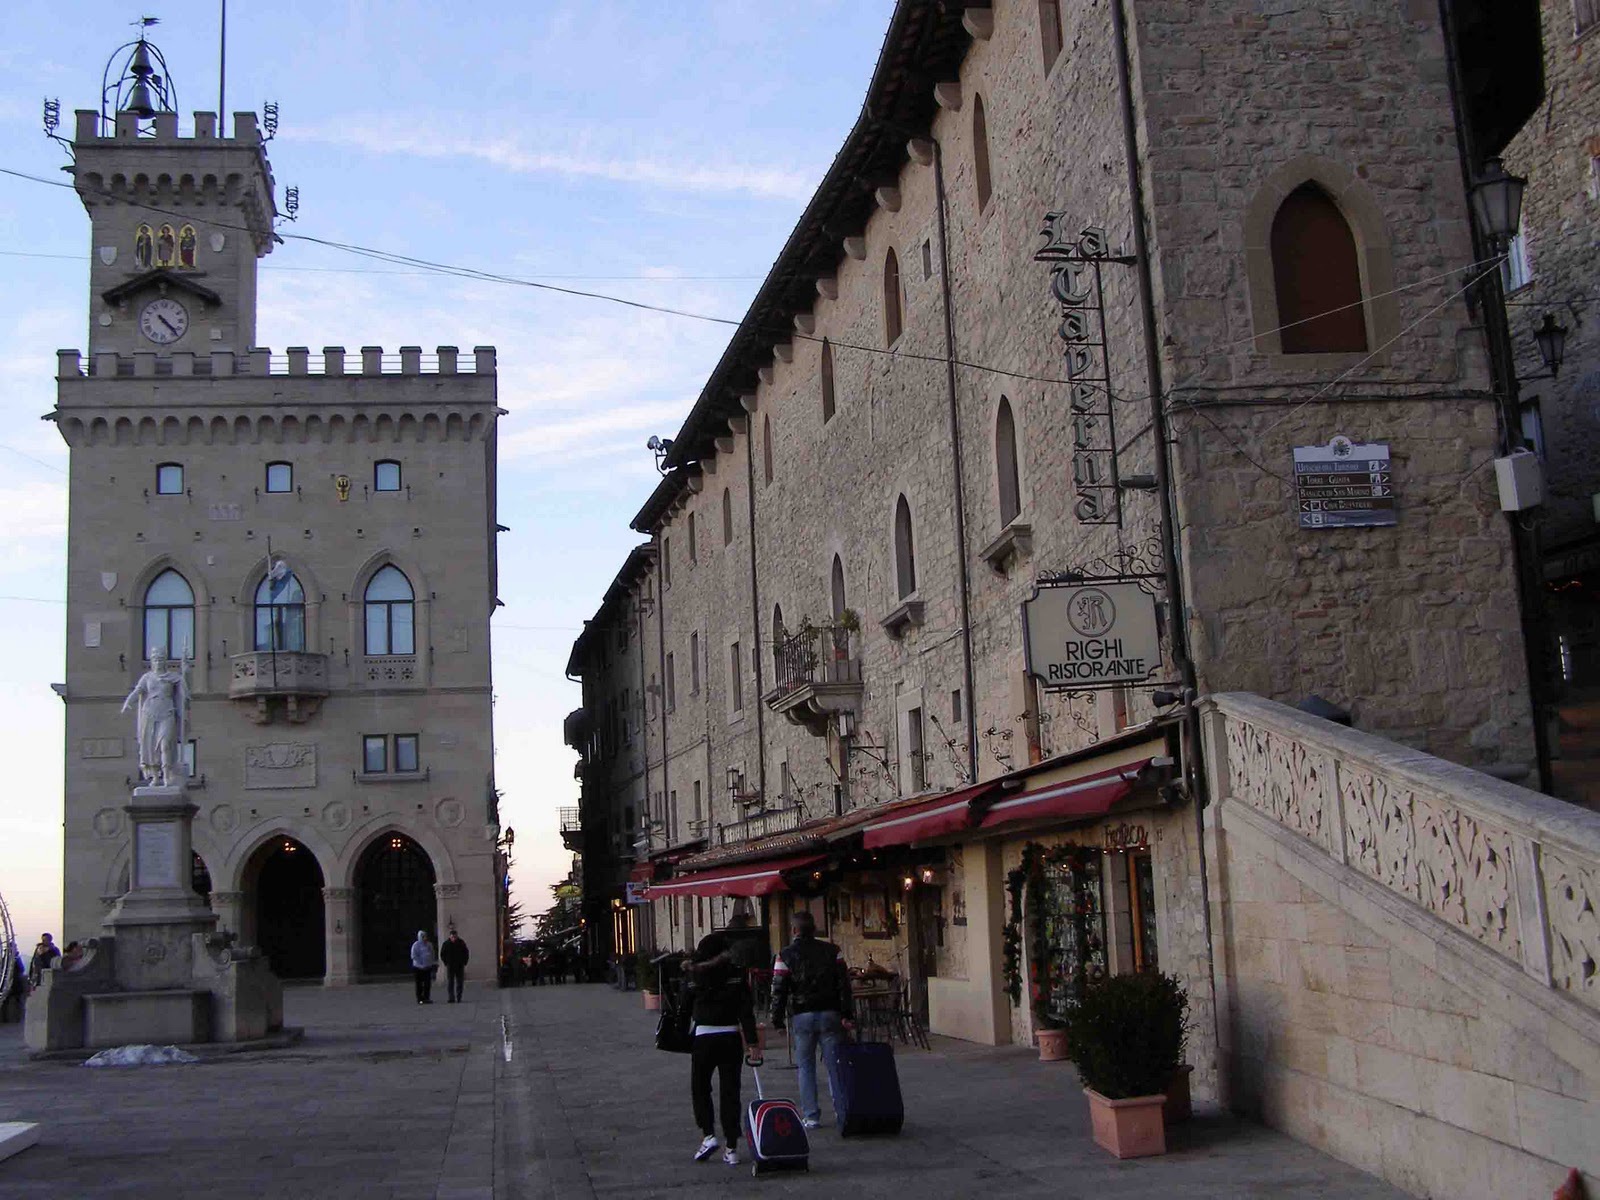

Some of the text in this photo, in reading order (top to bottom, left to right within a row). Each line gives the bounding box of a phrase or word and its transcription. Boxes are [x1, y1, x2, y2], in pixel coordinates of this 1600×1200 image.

[1038, 210, 1108, 257] La
[1050, 262, 1104, 521] Taverna
[1065, 638, 1124, 661] RIGHI
[1048, 658, 1145, 680] RISTORANTE
